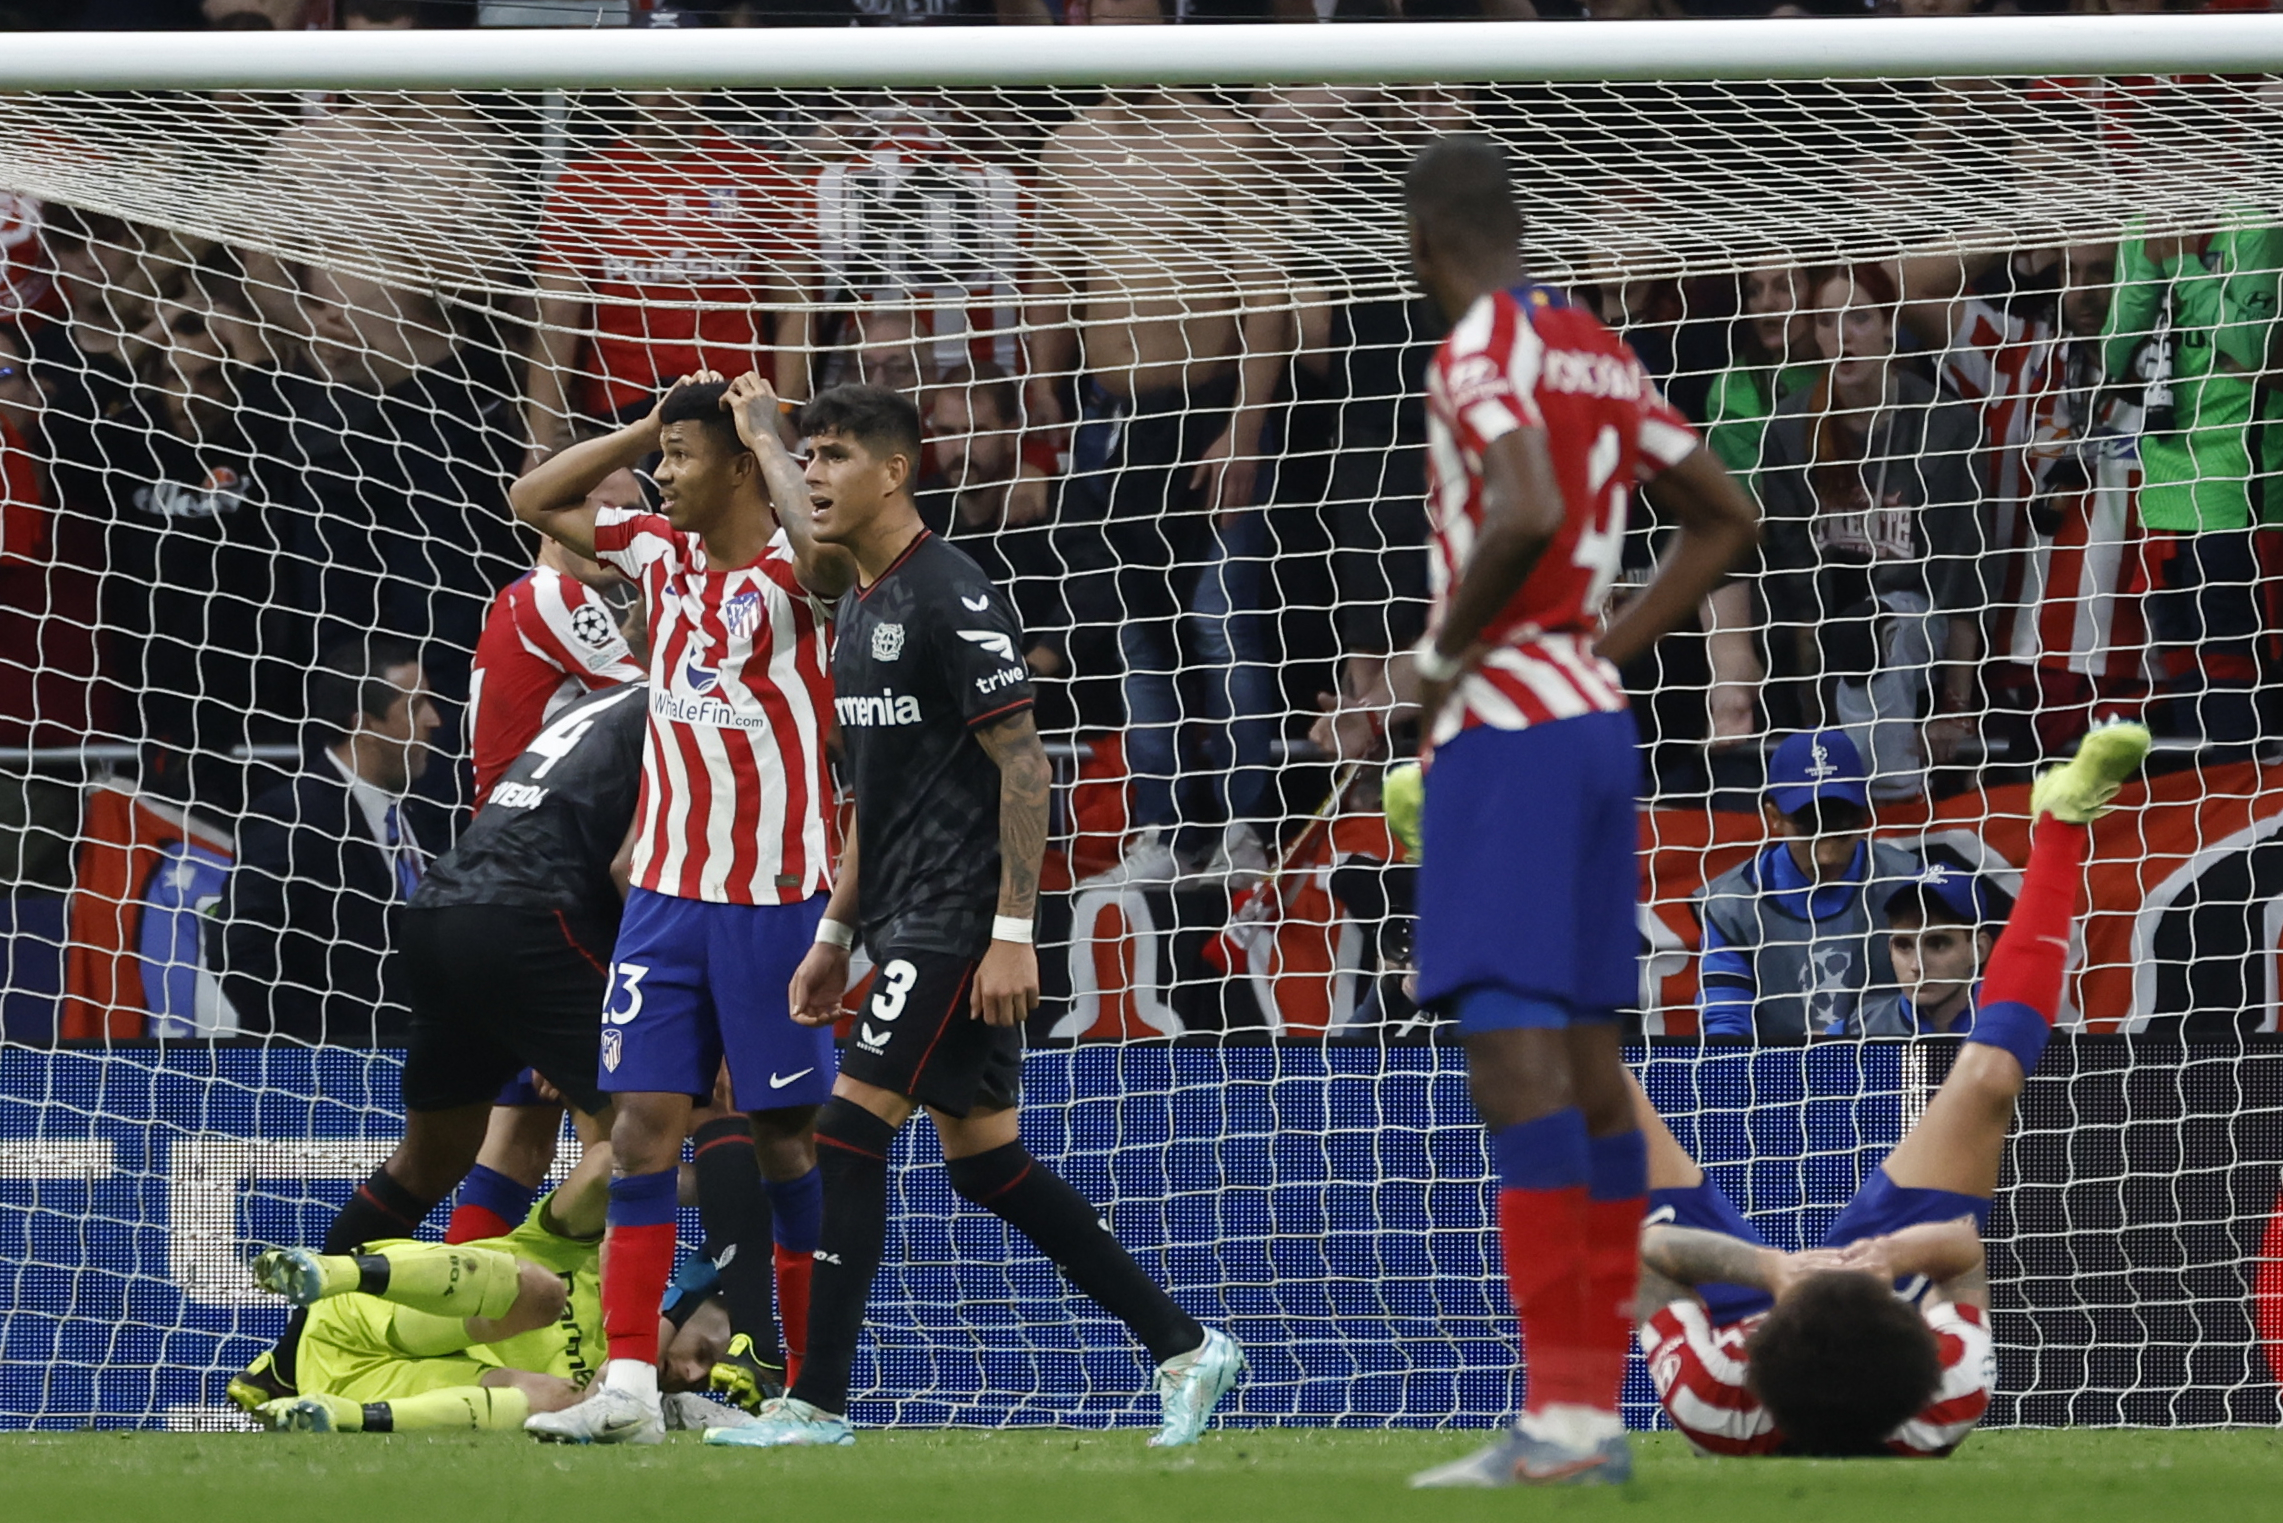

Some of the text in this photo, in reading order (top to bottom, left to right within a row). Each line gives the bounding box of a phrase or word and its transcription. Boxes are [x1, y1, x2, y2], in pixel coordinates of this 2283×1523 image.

[975, 666, 1025, 694] trive
[834, 687, 923, 726] rmenia
[525, 686, 640, 780] 4
[871, 959, 918, 1022] 3
